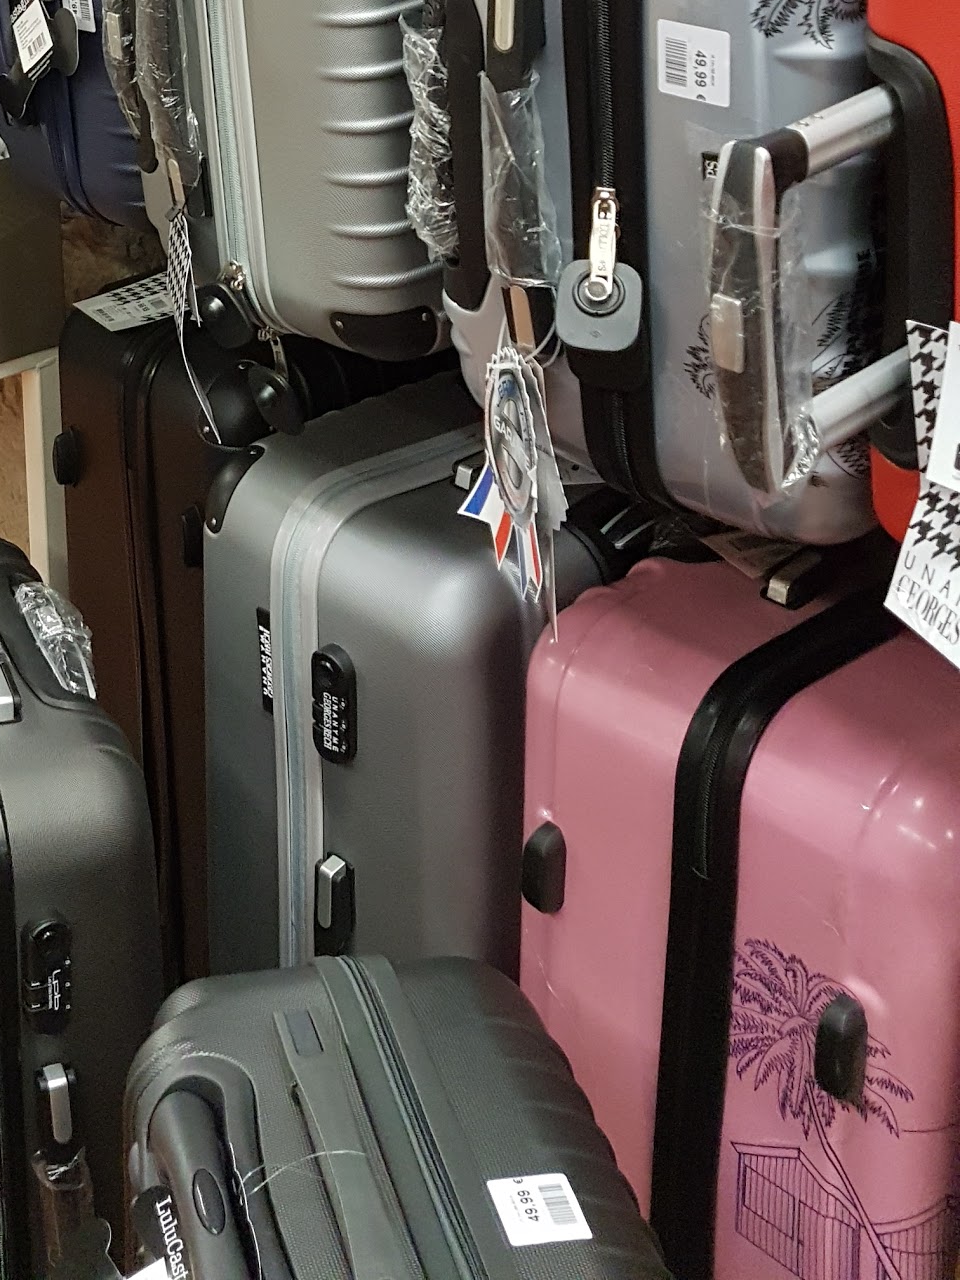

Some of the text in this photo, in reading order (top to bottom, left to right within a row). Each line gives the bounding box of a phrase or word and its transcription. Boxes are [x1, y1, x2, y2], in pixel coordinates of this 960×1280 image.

[692, 50, 708, 87] 49,99
[323, 692, 333, 750] GEORGES RECH
[332, 696, 340, 753] UNANYME
[517, 1190, 540, 1222] 49,99
[155, 1194, 189, 1280] LuluCast
